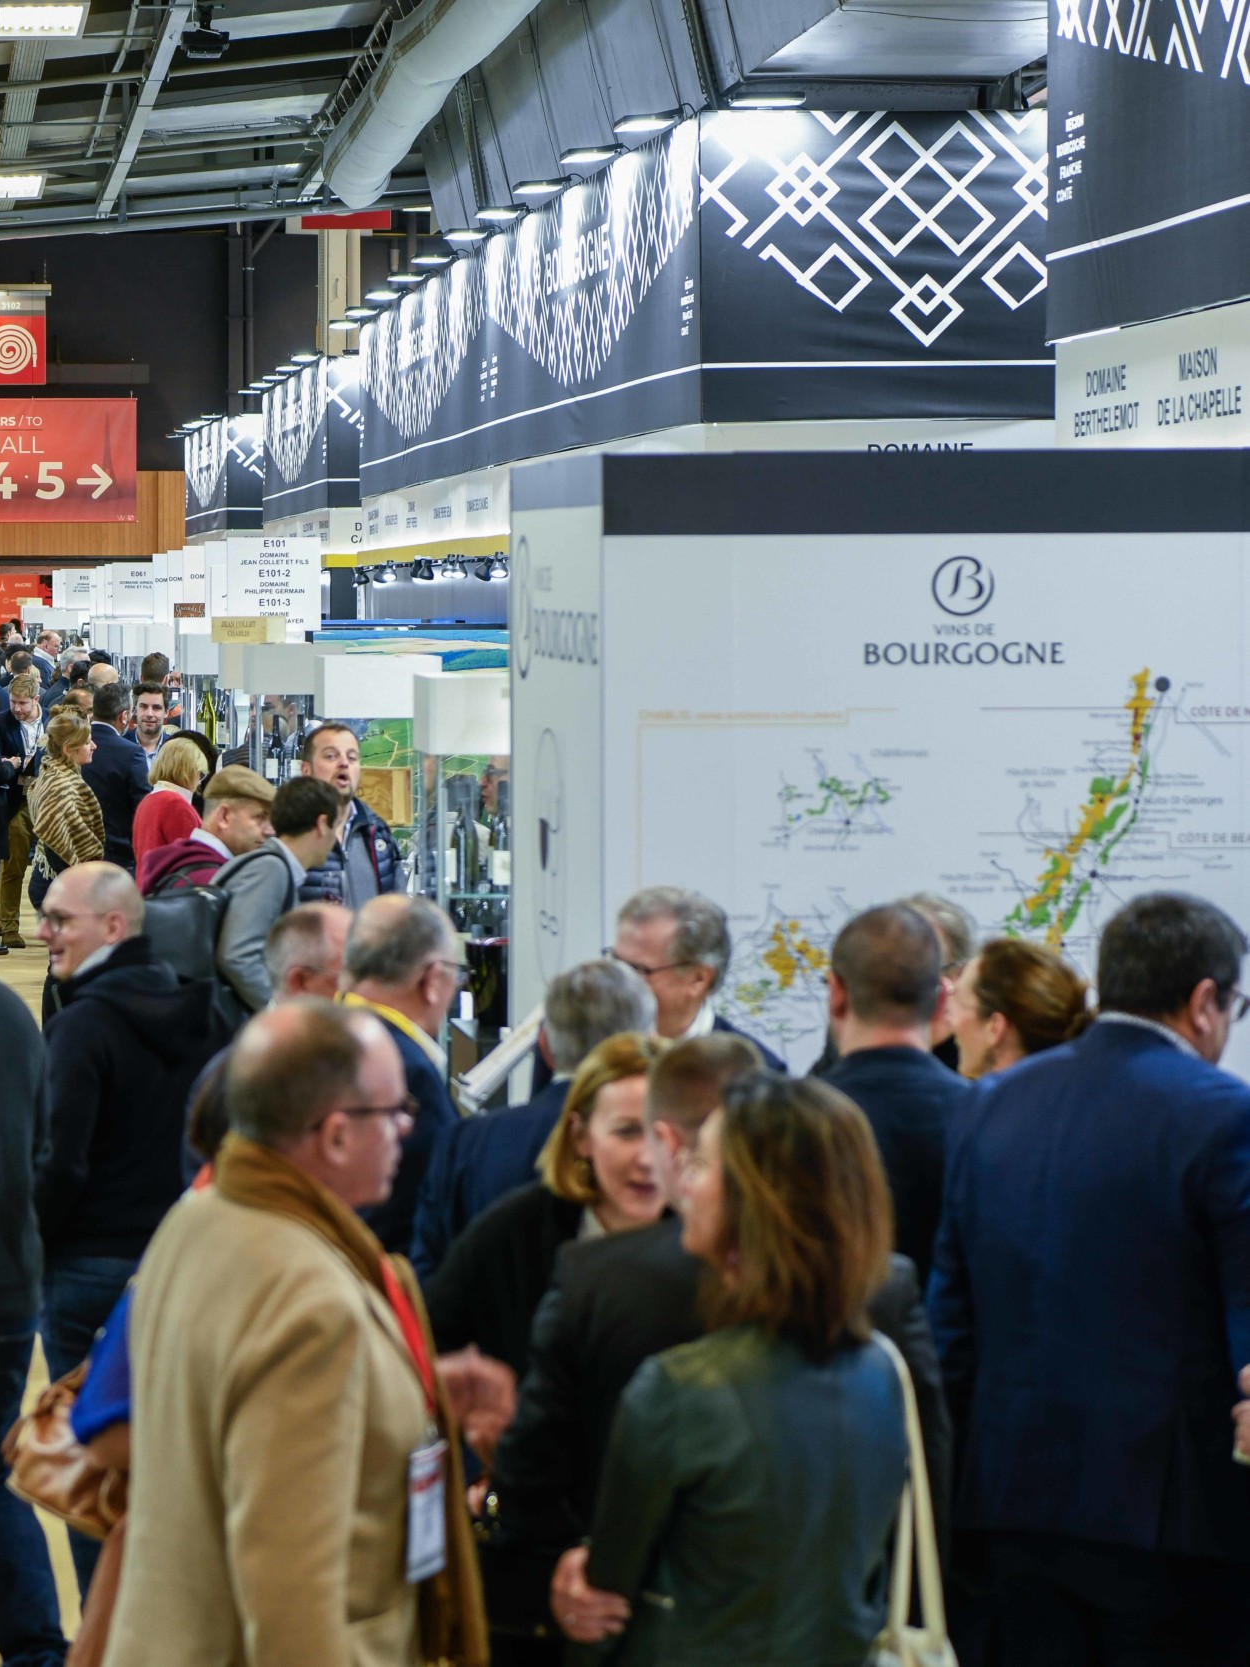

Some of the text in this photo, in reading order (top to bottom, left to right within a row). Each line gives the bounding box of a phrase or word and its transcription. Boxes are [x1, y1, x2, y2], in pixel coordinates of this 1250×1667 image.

[0, 301, 21, 310] 3102
[1178, 346, 1218, 382] MAISON
[1086, 364, 1126, 397] DOMAINE
[1157, 385, 1242, 426] DE LA CHAPELLE
[26, 416, 43, 426] TO
[1074, 402, 1140, 438] BERTHELEMOT
[258, 569, 291, 577] E101-2
[934, 623, 995, 636] VINS DE
[863, 641, 1065, 665] BOURGOGNE
[1190, 705, 1222, 717] CÔTE
[1225, 706, 1240, 717] DE
